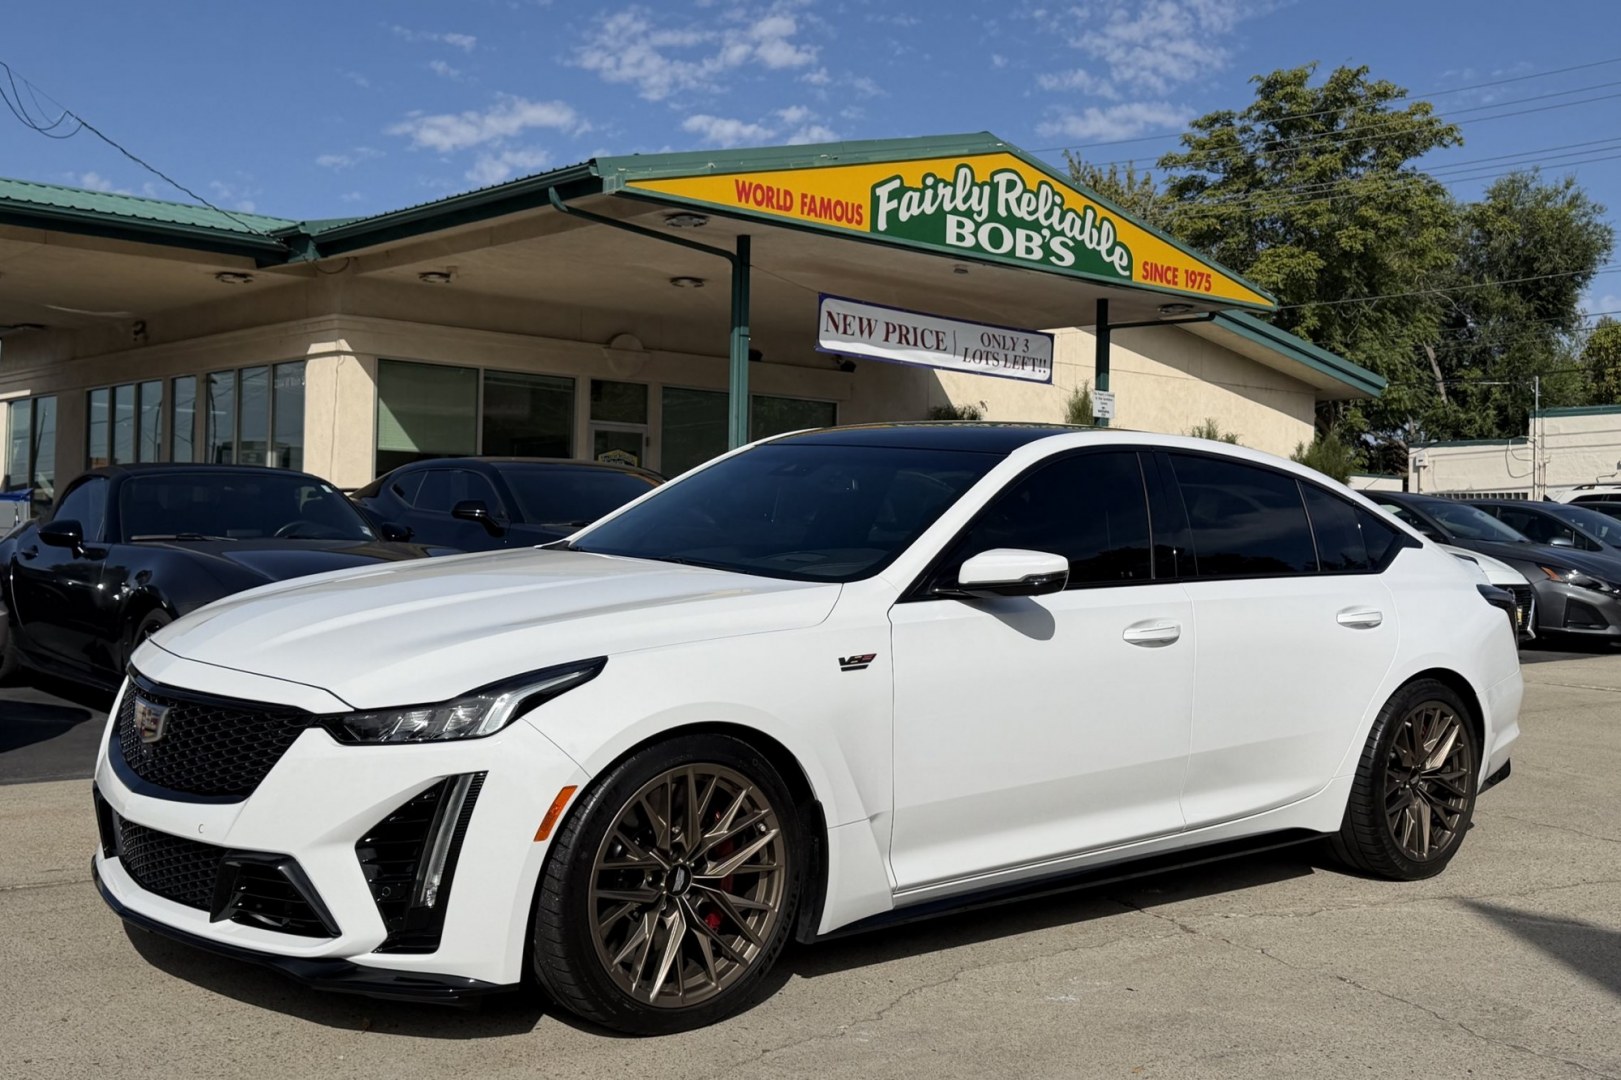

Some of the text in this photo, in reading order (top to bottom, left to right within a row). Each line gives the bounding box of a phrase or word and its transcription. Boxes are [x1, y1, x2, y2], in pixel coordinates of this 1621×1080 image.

[735, 179, 864, 226] WORLD FAMOUS
[875, 167, 1130, 276] Fairly Reliable
[945, 214, 1076, 267] BOB'S
[1142, 261, 1212, 292] SINCE 1975
[825, 310, 948, 352] NEW PRICE
[980, 331, 1030, 353] ONLY 3
[962, 347, 1047, 374] LOTS LEFT!!
